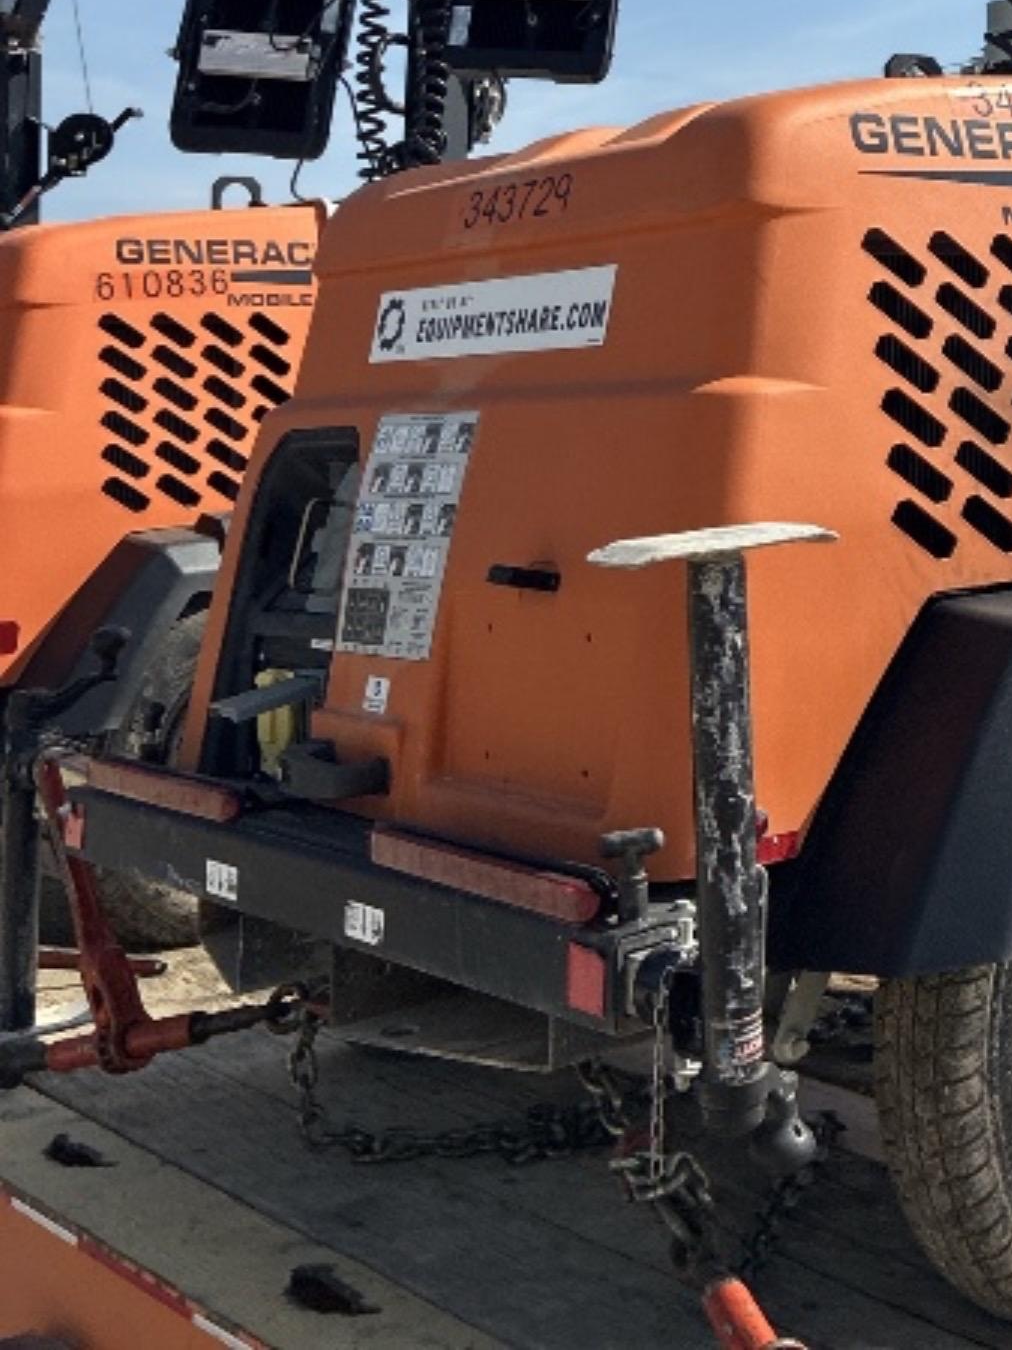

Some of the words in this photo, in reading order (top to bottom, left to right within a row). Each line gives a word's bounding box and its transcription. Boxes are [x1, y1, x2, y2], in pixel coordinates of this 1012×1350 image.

[464, 173, 574, 229] 343729
[116, 238, 313, 266] GENERAC
[95, 269, 228, 301] 610836
[226, 293, 313, 307] MOBILE
[415, 299, 608, 343] EQUIPMENTSHARE.COM
